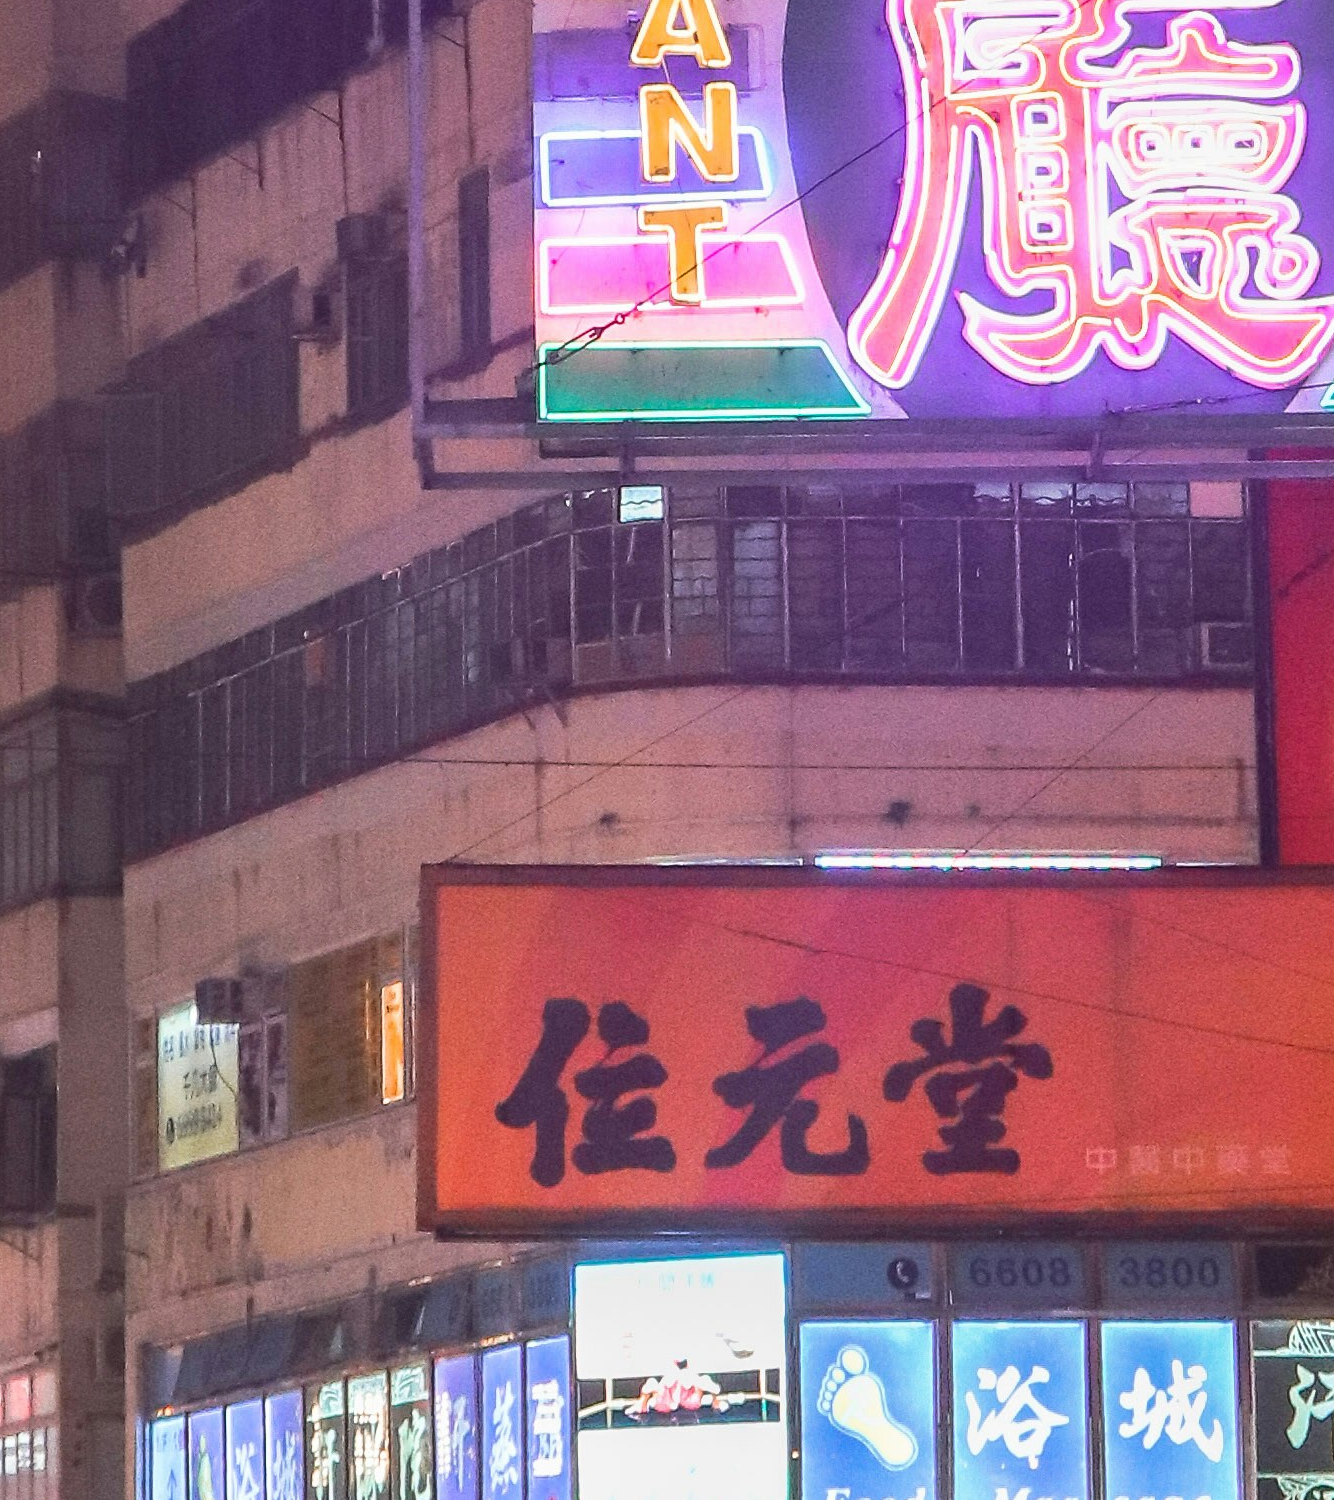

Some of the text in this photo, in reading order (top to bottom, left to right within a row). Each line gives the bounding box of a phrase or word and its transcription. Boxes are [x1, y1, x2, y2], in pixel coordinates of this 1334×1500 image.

[495, 985, 1056, 1187] 位元堂
[970, 1256, 1221, 1290] 6608 3800
